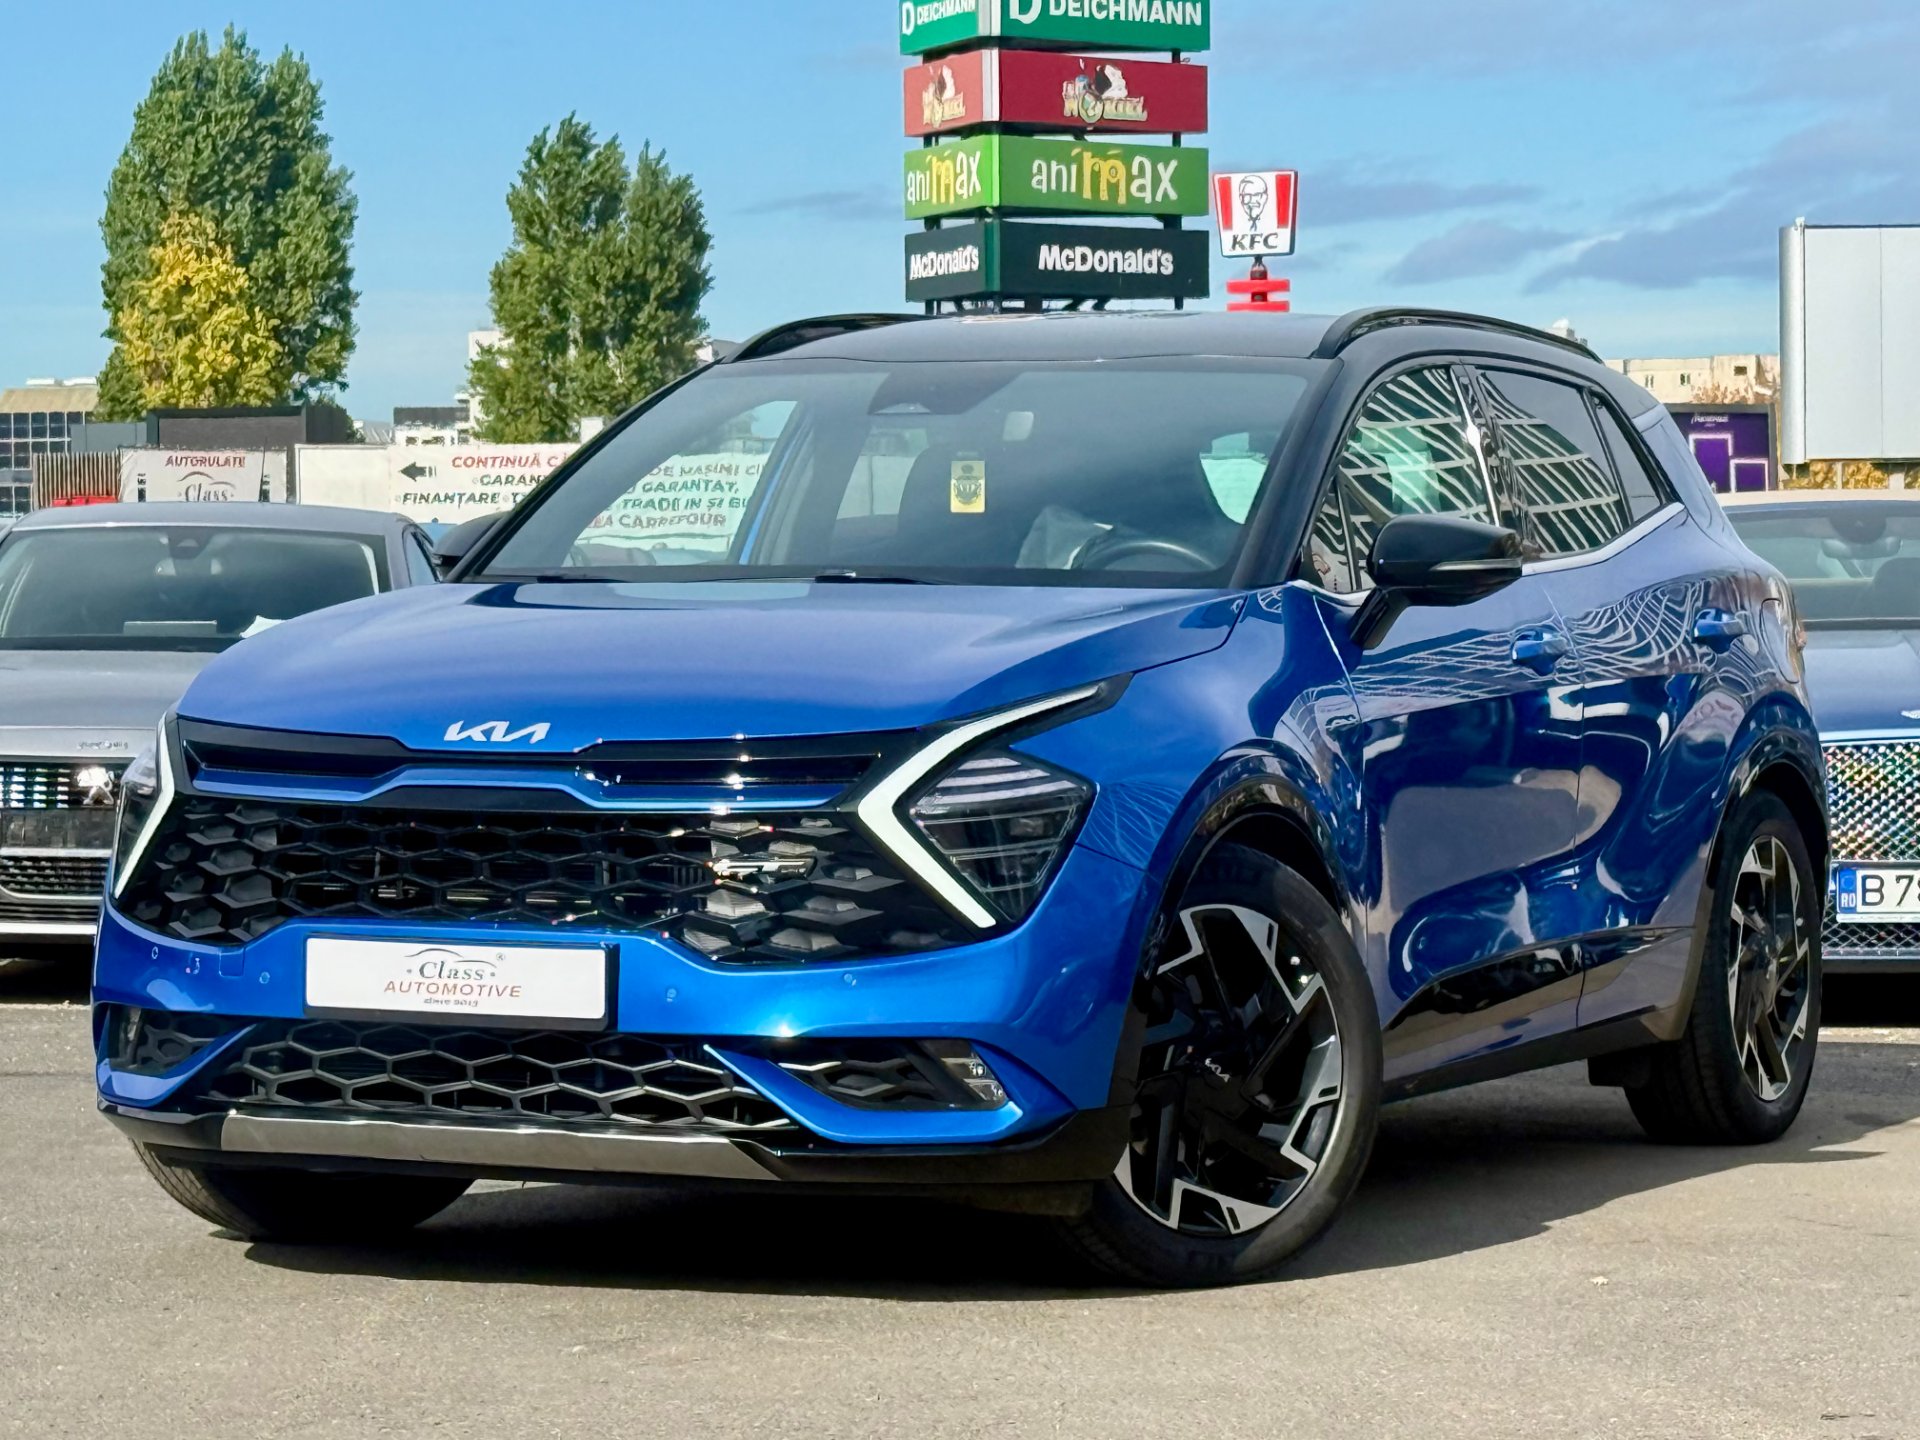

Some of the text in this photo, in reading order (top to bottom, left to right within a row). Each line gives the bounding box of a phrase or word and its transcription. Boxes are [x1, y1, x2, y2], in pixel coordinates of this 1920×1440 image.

[917, 0, 976, 25] DEICHMANN
[1049, 0, 1202, 26] DEICHMANN
[907, 150, 982, 206] animax
[1031, 148, 1178, 205] animax
[1230, 232, 1279, 252] KFC
[910, 245, 979, 280] McDonald's
[1038, 244, 1174, 276] McDonald's
[1841, 874, 1920, 907] RO B 7
[419, 960, 485, 980] Class
[384, 981, 522, 998] AUTOMOTIVE
